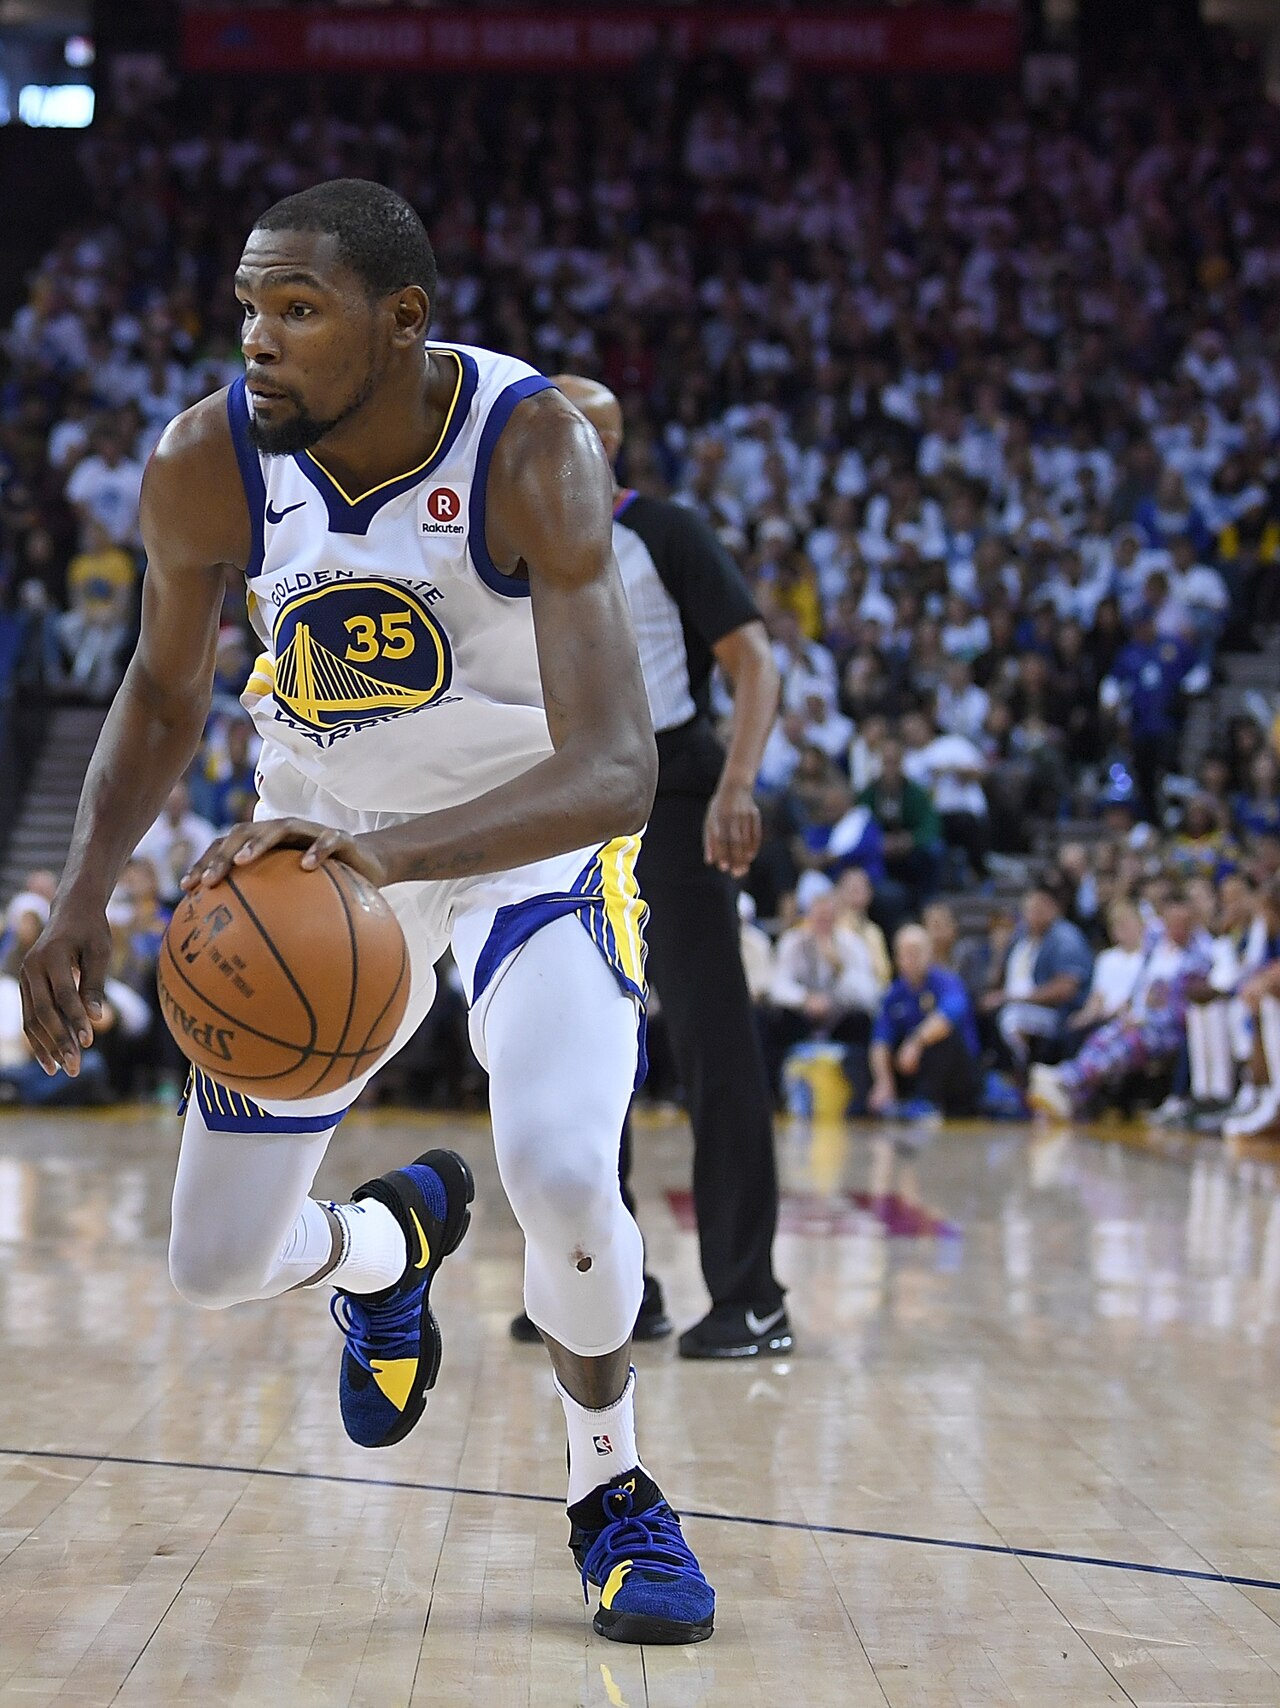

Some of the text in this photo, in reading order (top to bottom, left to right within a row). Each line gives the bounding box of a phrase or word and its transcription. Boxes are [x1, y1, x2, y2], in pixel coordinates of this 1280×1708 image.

[422, 522, 465, 534] Rakuten
[271, 569, 354, 607] GOLDEN
[343, 609, 416, 663] 35
